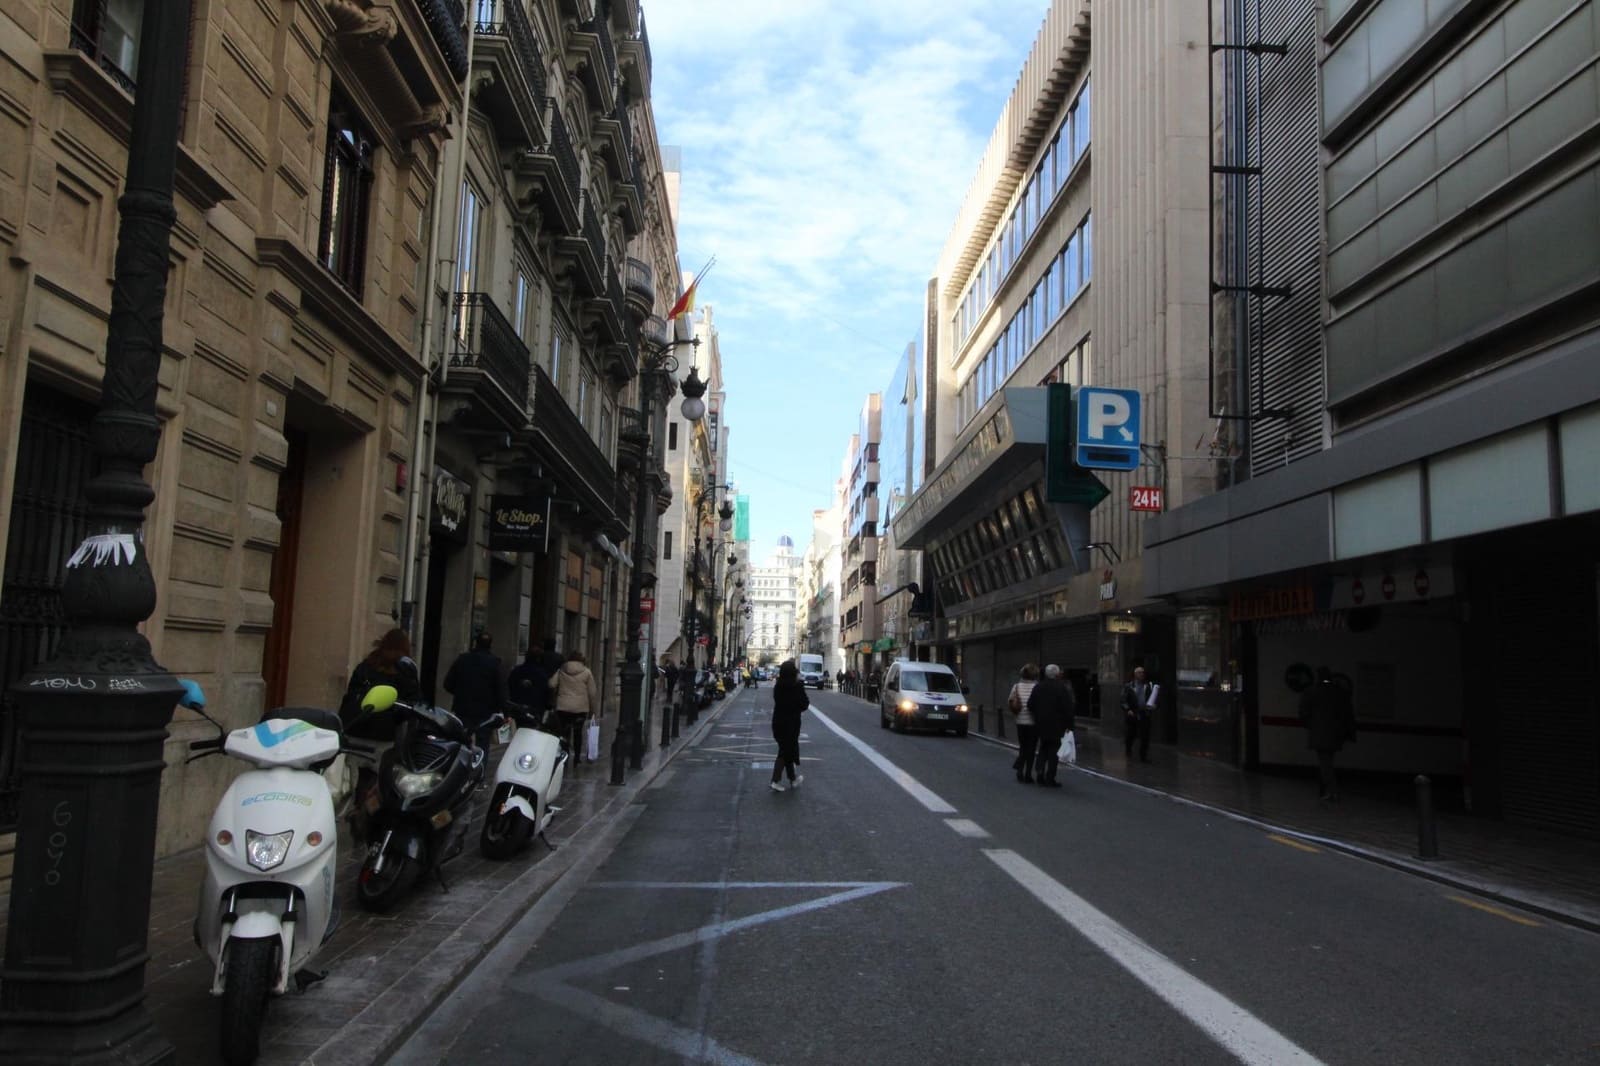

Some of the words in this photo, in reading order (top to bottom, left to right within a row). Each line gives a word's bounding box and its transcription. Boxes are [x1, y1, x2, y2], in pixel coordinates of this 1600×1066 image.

[1088, 391, 1130, 440] P
[1132, 489, 1160, 508] 24H
[496, 507, 509, 526] Le
